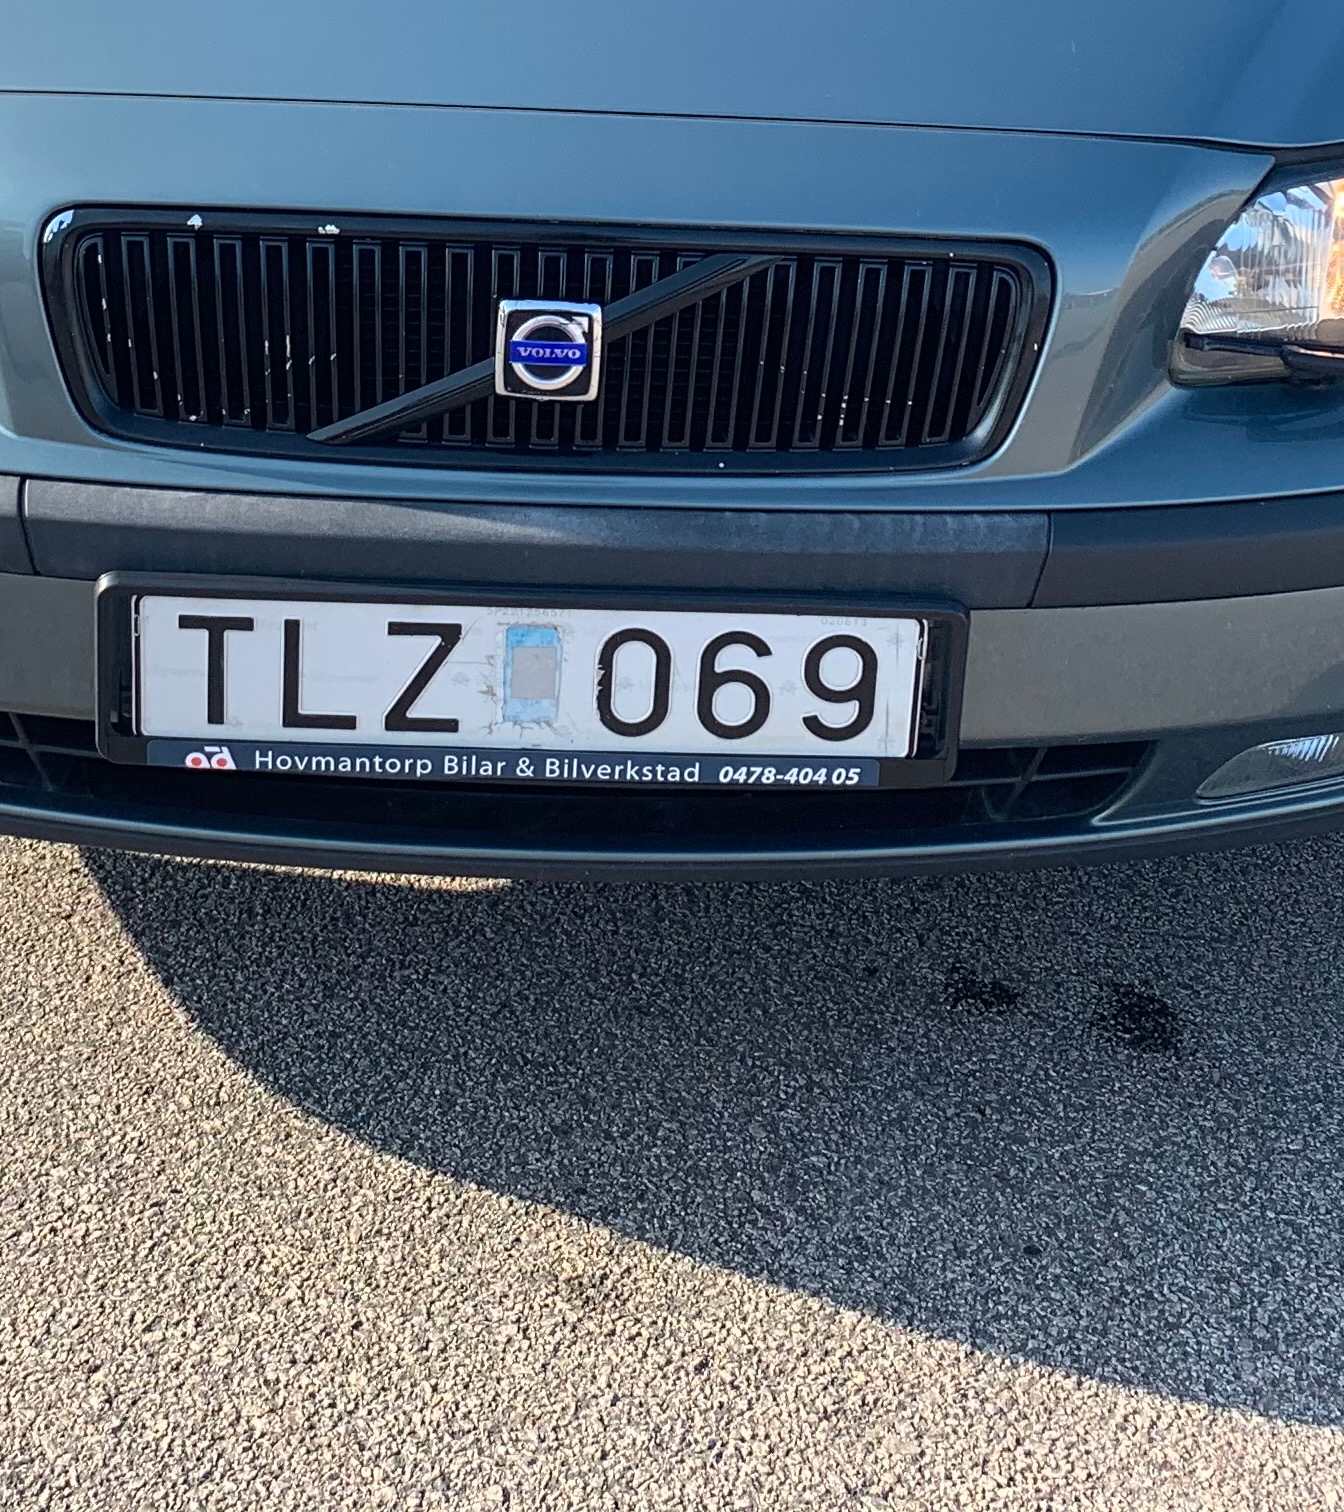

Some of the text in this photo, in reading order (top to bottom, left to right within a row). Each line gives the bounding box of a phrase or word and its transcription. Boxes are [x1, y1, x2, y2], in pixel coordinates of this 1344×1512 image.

[516, 346, 582, 359] VOLVO
[177, 613, 879, 742] TLZ 069
[254, 749, 433, 777] Hovmantorp
[443, 753, 503, 776] Bilar
[515, 757, 535, 778] &
[544, 757, 700, 784] Bilverkstad
